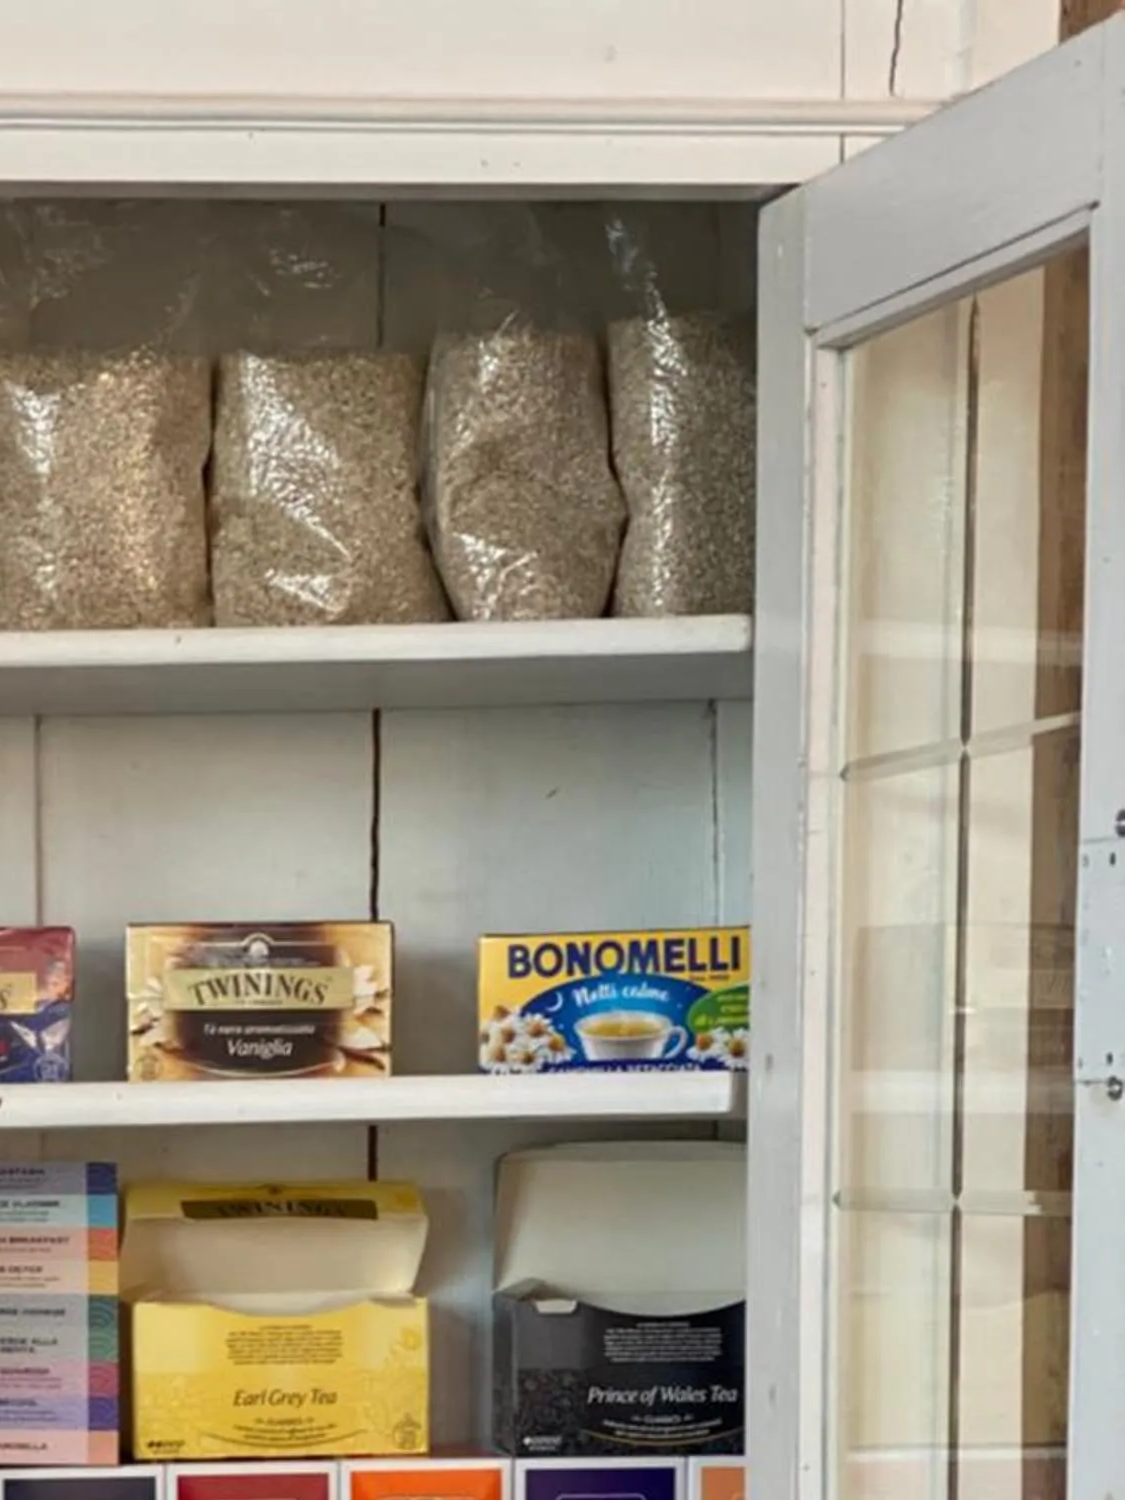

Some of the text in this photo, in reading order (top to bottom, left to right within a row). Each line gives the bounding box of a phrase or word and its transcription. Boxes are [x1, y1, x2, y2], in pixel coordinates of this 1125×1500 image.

[507, 936, 741, 979] BONOMELLI
[187, 971, 330, 1006] TWININGS
[227, 1038, 294, 1060] Vaniglia
[233, 1388, 338, 1410] Earl Grey Tea
[587, 1384, 738, 1407] Prince of Wales Tea
